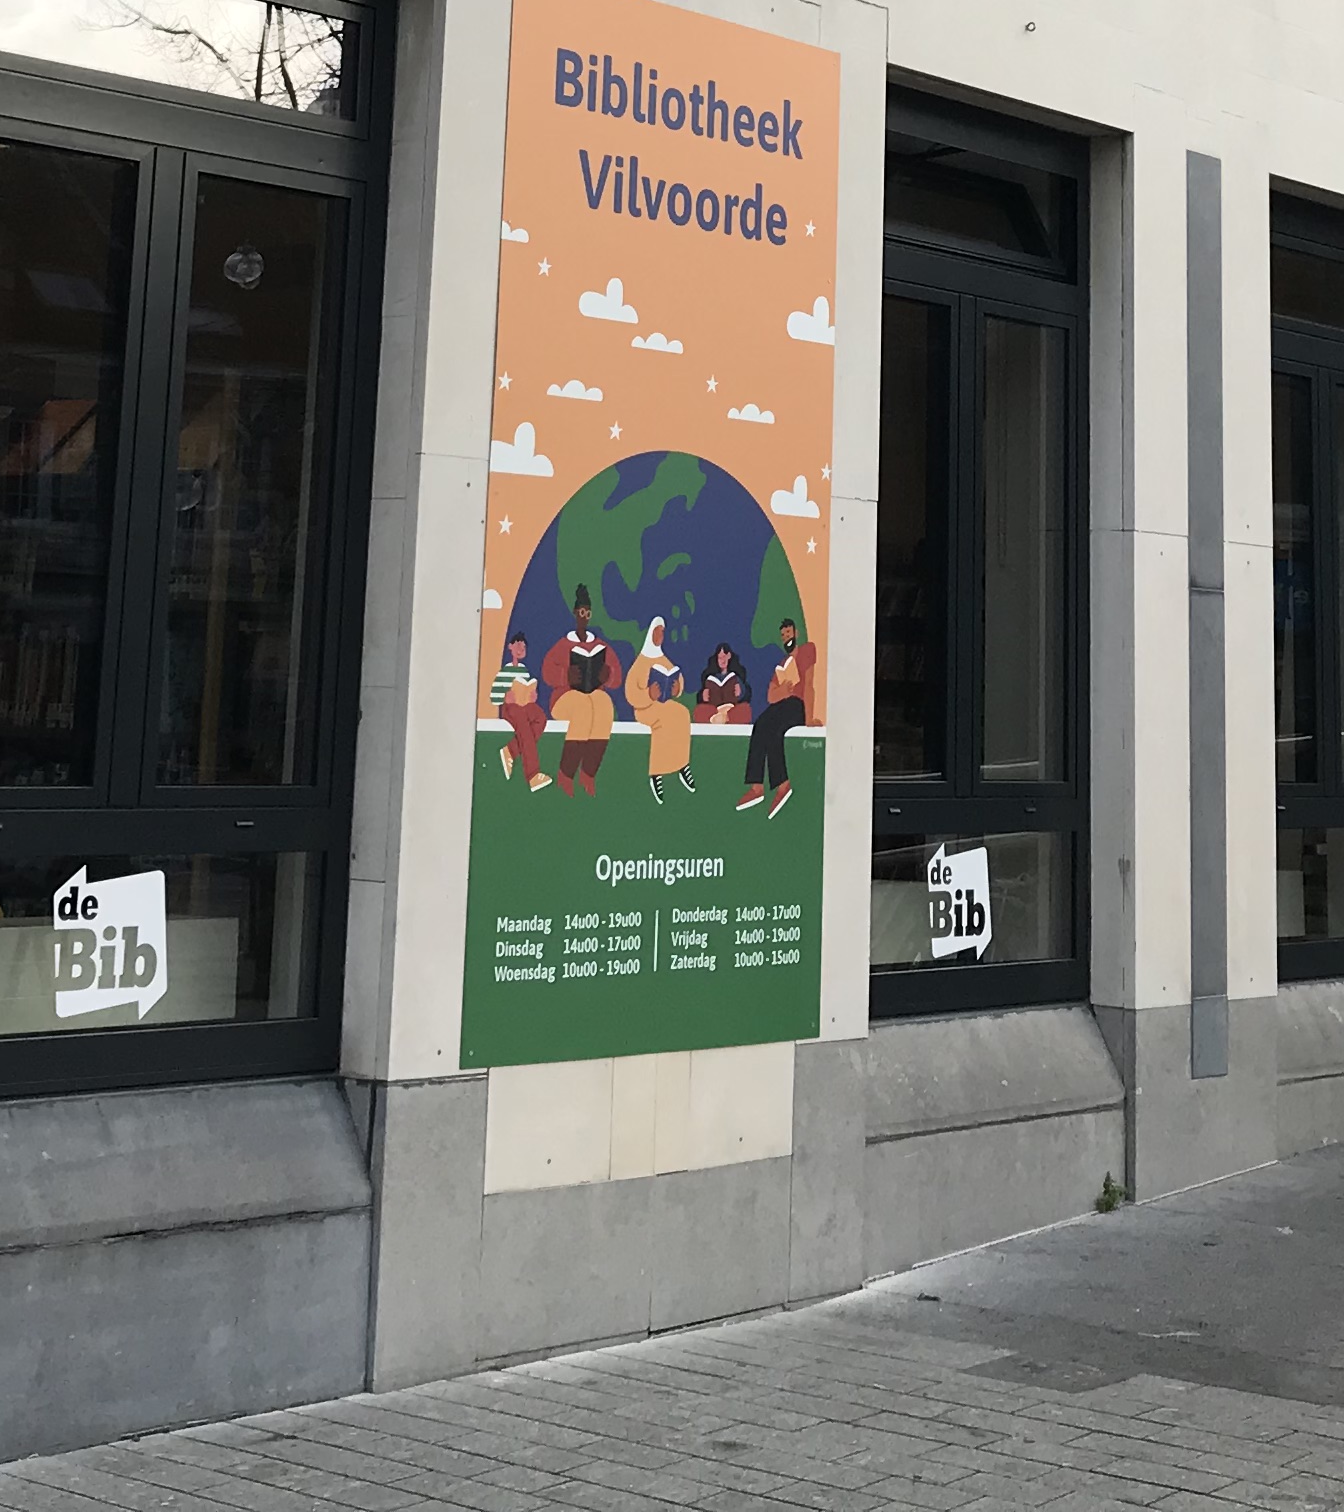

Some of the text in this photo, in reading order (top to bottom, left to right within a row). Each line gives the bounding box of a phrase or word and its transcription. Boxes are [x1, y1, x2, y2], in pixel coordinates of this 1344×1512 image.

[554, 47, 803, 159] Bibliotheek
[579, 149, 788, 245] Vilvoorde
[595, 853, 724, 887] Openingsuren
[930, 859, 952, 885] de
[58, 886, 99, 921] de
[672, 906, 728, 925] Donderdag
[735, 906, 765, 922] 14u00
[772, 904, 801, 920] 17u00
[929, 889, 986, 938] Bib
[496, 914, 552, 934] Maandag
[564, 913, 599, 930] 14u00
[608, 911, 642, 928] 19u00
[495, 939, 544, 959] Dinsdag
[563, 937, 598, 954] 14u00
[607, 935, 641, 952] 17u00
[671, 929, 708, 950] Vrijdag
[734, 929, 764, 945] 14u00
[772, 927, 801, 943] 19u00
[54, 925, 158, 992] Bib
[494, 963, 556, 983] Woensdag
[562, 961, 597, 978] 10u00
[606, 959, 640, 976] 19u00
[670, 953, 717, 971] Zaterdag
[734, 951, 764, 968] 10u00
[771, 949, 800, 965] 15u00
